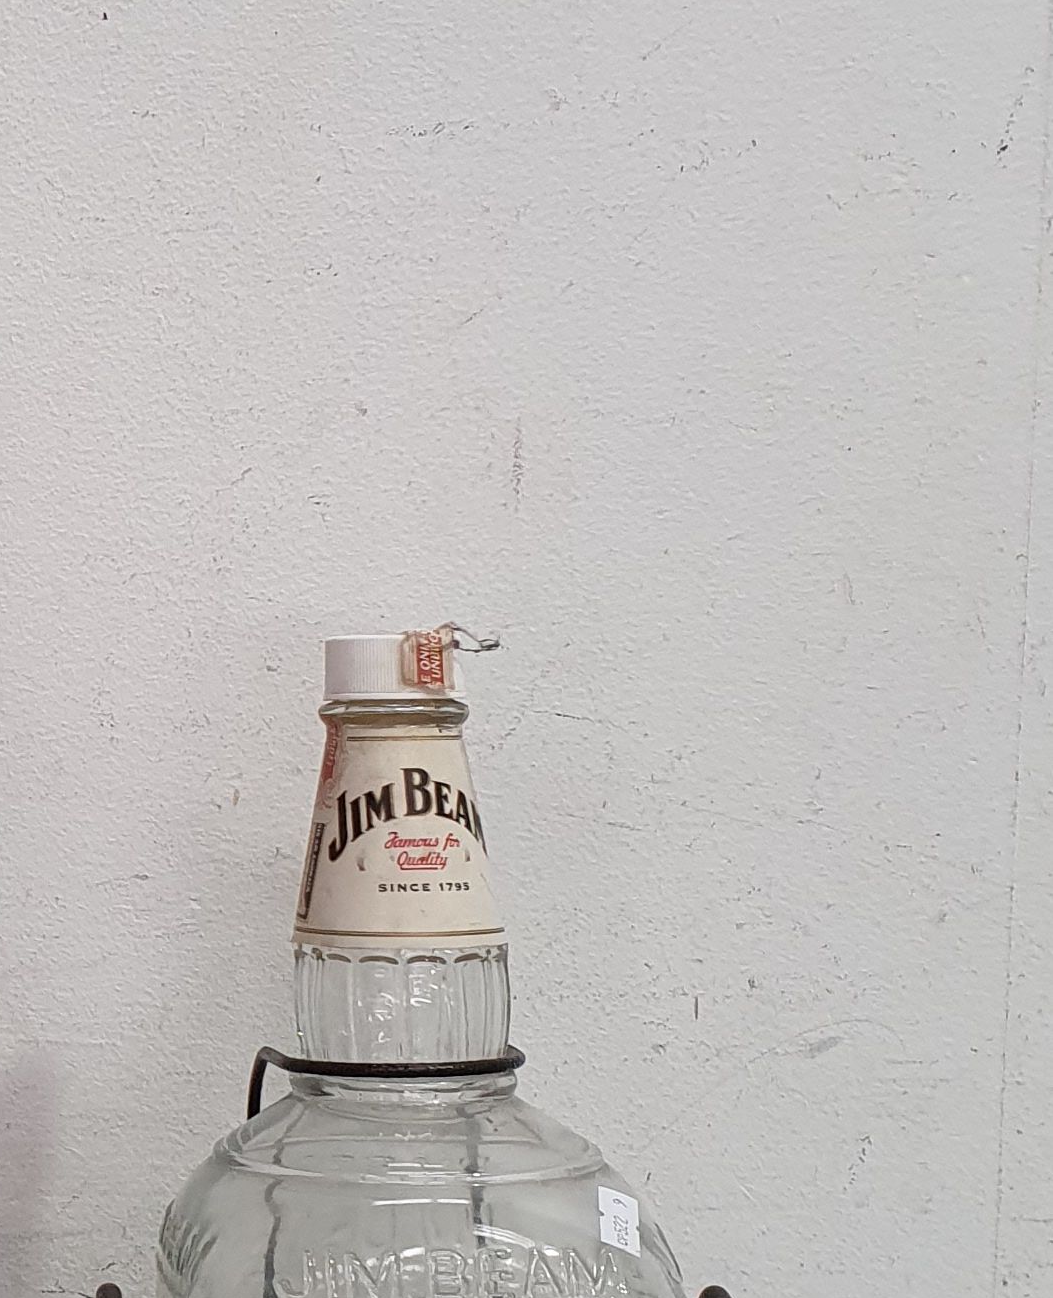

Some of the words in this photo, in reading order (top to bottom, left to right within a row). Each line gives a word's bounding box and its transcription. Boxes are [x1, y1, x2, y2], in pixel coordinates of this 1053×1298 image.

[329, 782, 398, 863] JIM
[384, 831, 439, 849] Famous
[443, 833, 460, 851] for
[397, 851, 448, 869] Quality
[378, 883, 431, 893] SINCE
[439, 882, 470, 892] 1795
